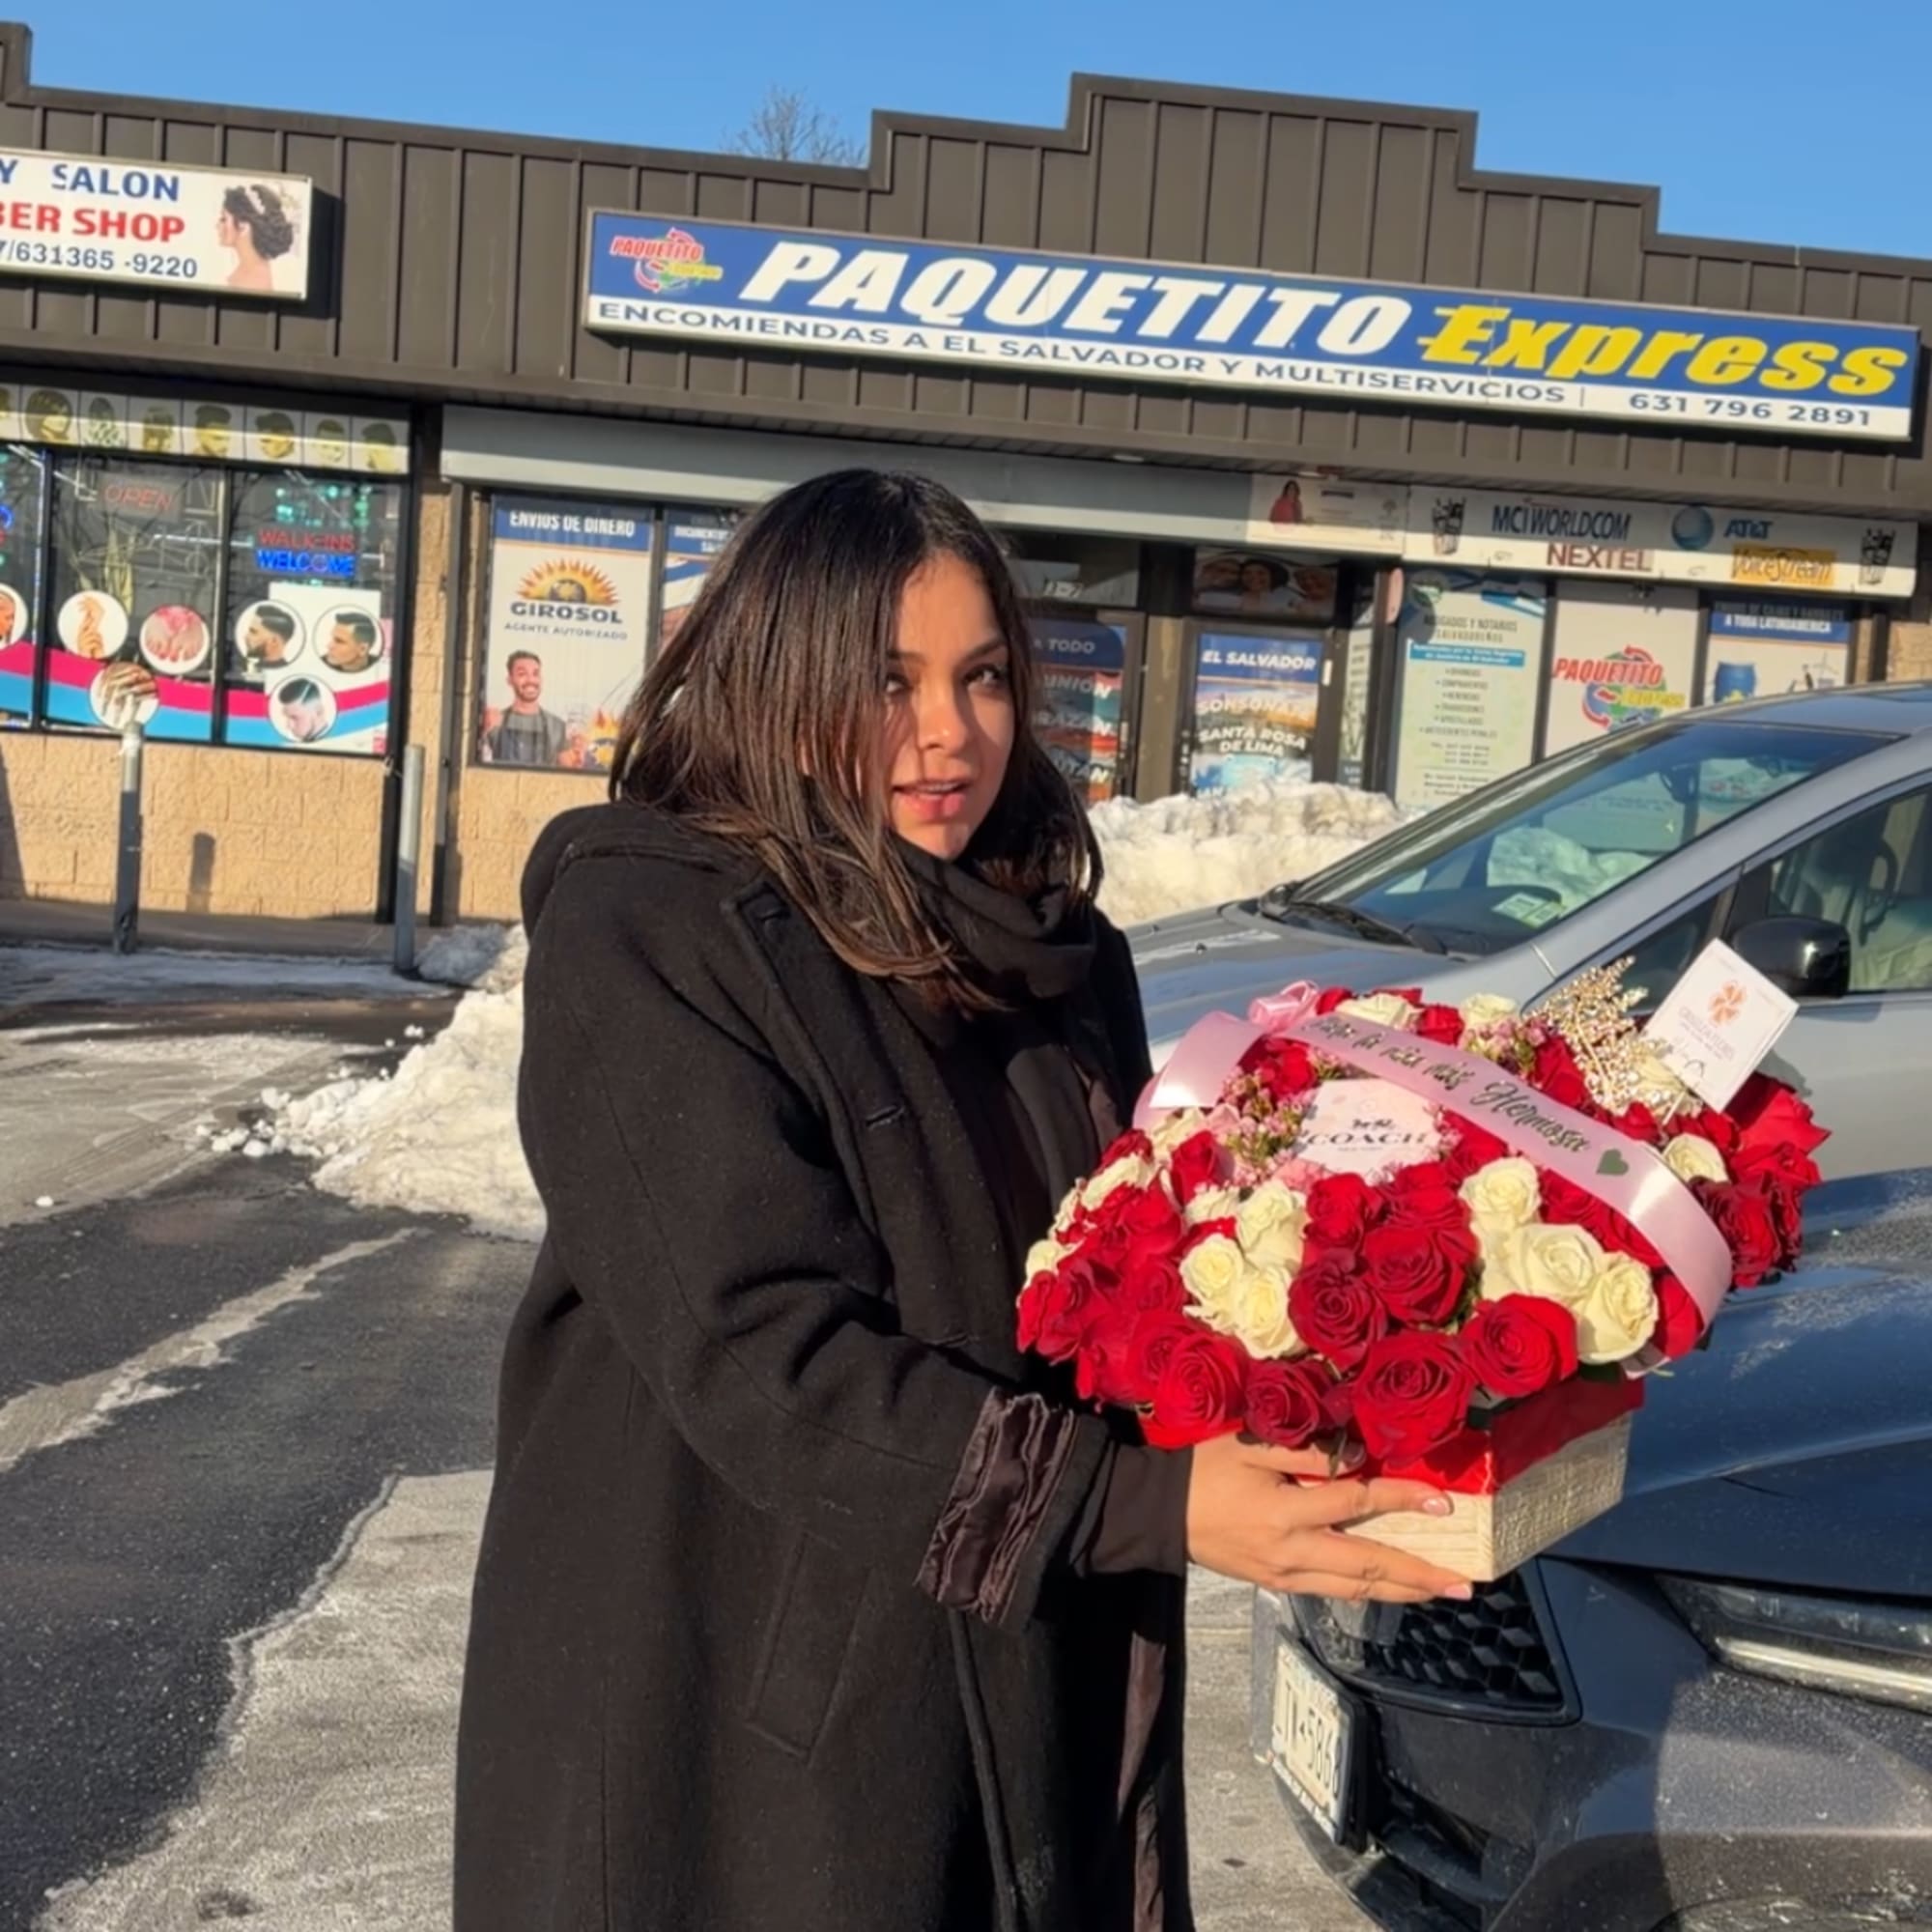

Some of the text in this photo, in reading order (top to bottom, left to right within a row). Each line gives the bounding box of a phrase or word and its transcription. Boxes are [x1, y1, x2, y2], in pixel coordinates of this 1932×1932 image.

[51, 163, 180, 202] SALON
[72, 208, 185, 242] SHOP
[610, 236, 704, 264] PAQUETITO
[738, 241, 1908, 397] PAQUETITO Express
[599, 301, 1870, 426] ENCOMIENDAS A EL SALVADOR Y MULTISERVICIOS 631 796 2891
[103, 483, 174, 511] OPEN
[562, 514, 581, 531] DE
[583, 518, 636, 538] DINERO
[1723, 519, 1774, 540] AT&T
[256, 549, 357, 579] WELCOME
[1547, 542, 1653, 572] NEXTEL
[510, 602, 623, 624] GIROSOL
[504, 623, 628, 640] AGENTE AUTORIZADO
[1047, 639, 1095, 655] TODO
[1202, 649, 1318, 671] EL SALVADOR
[1553, 658, 1663, 686] PAQUETITO
[1198, 726, 1307, 751] SANTA ROSA
[1219, 739, 1285, 756] DE LIMA
[1306, 1132, 1428, 1146] COACH
